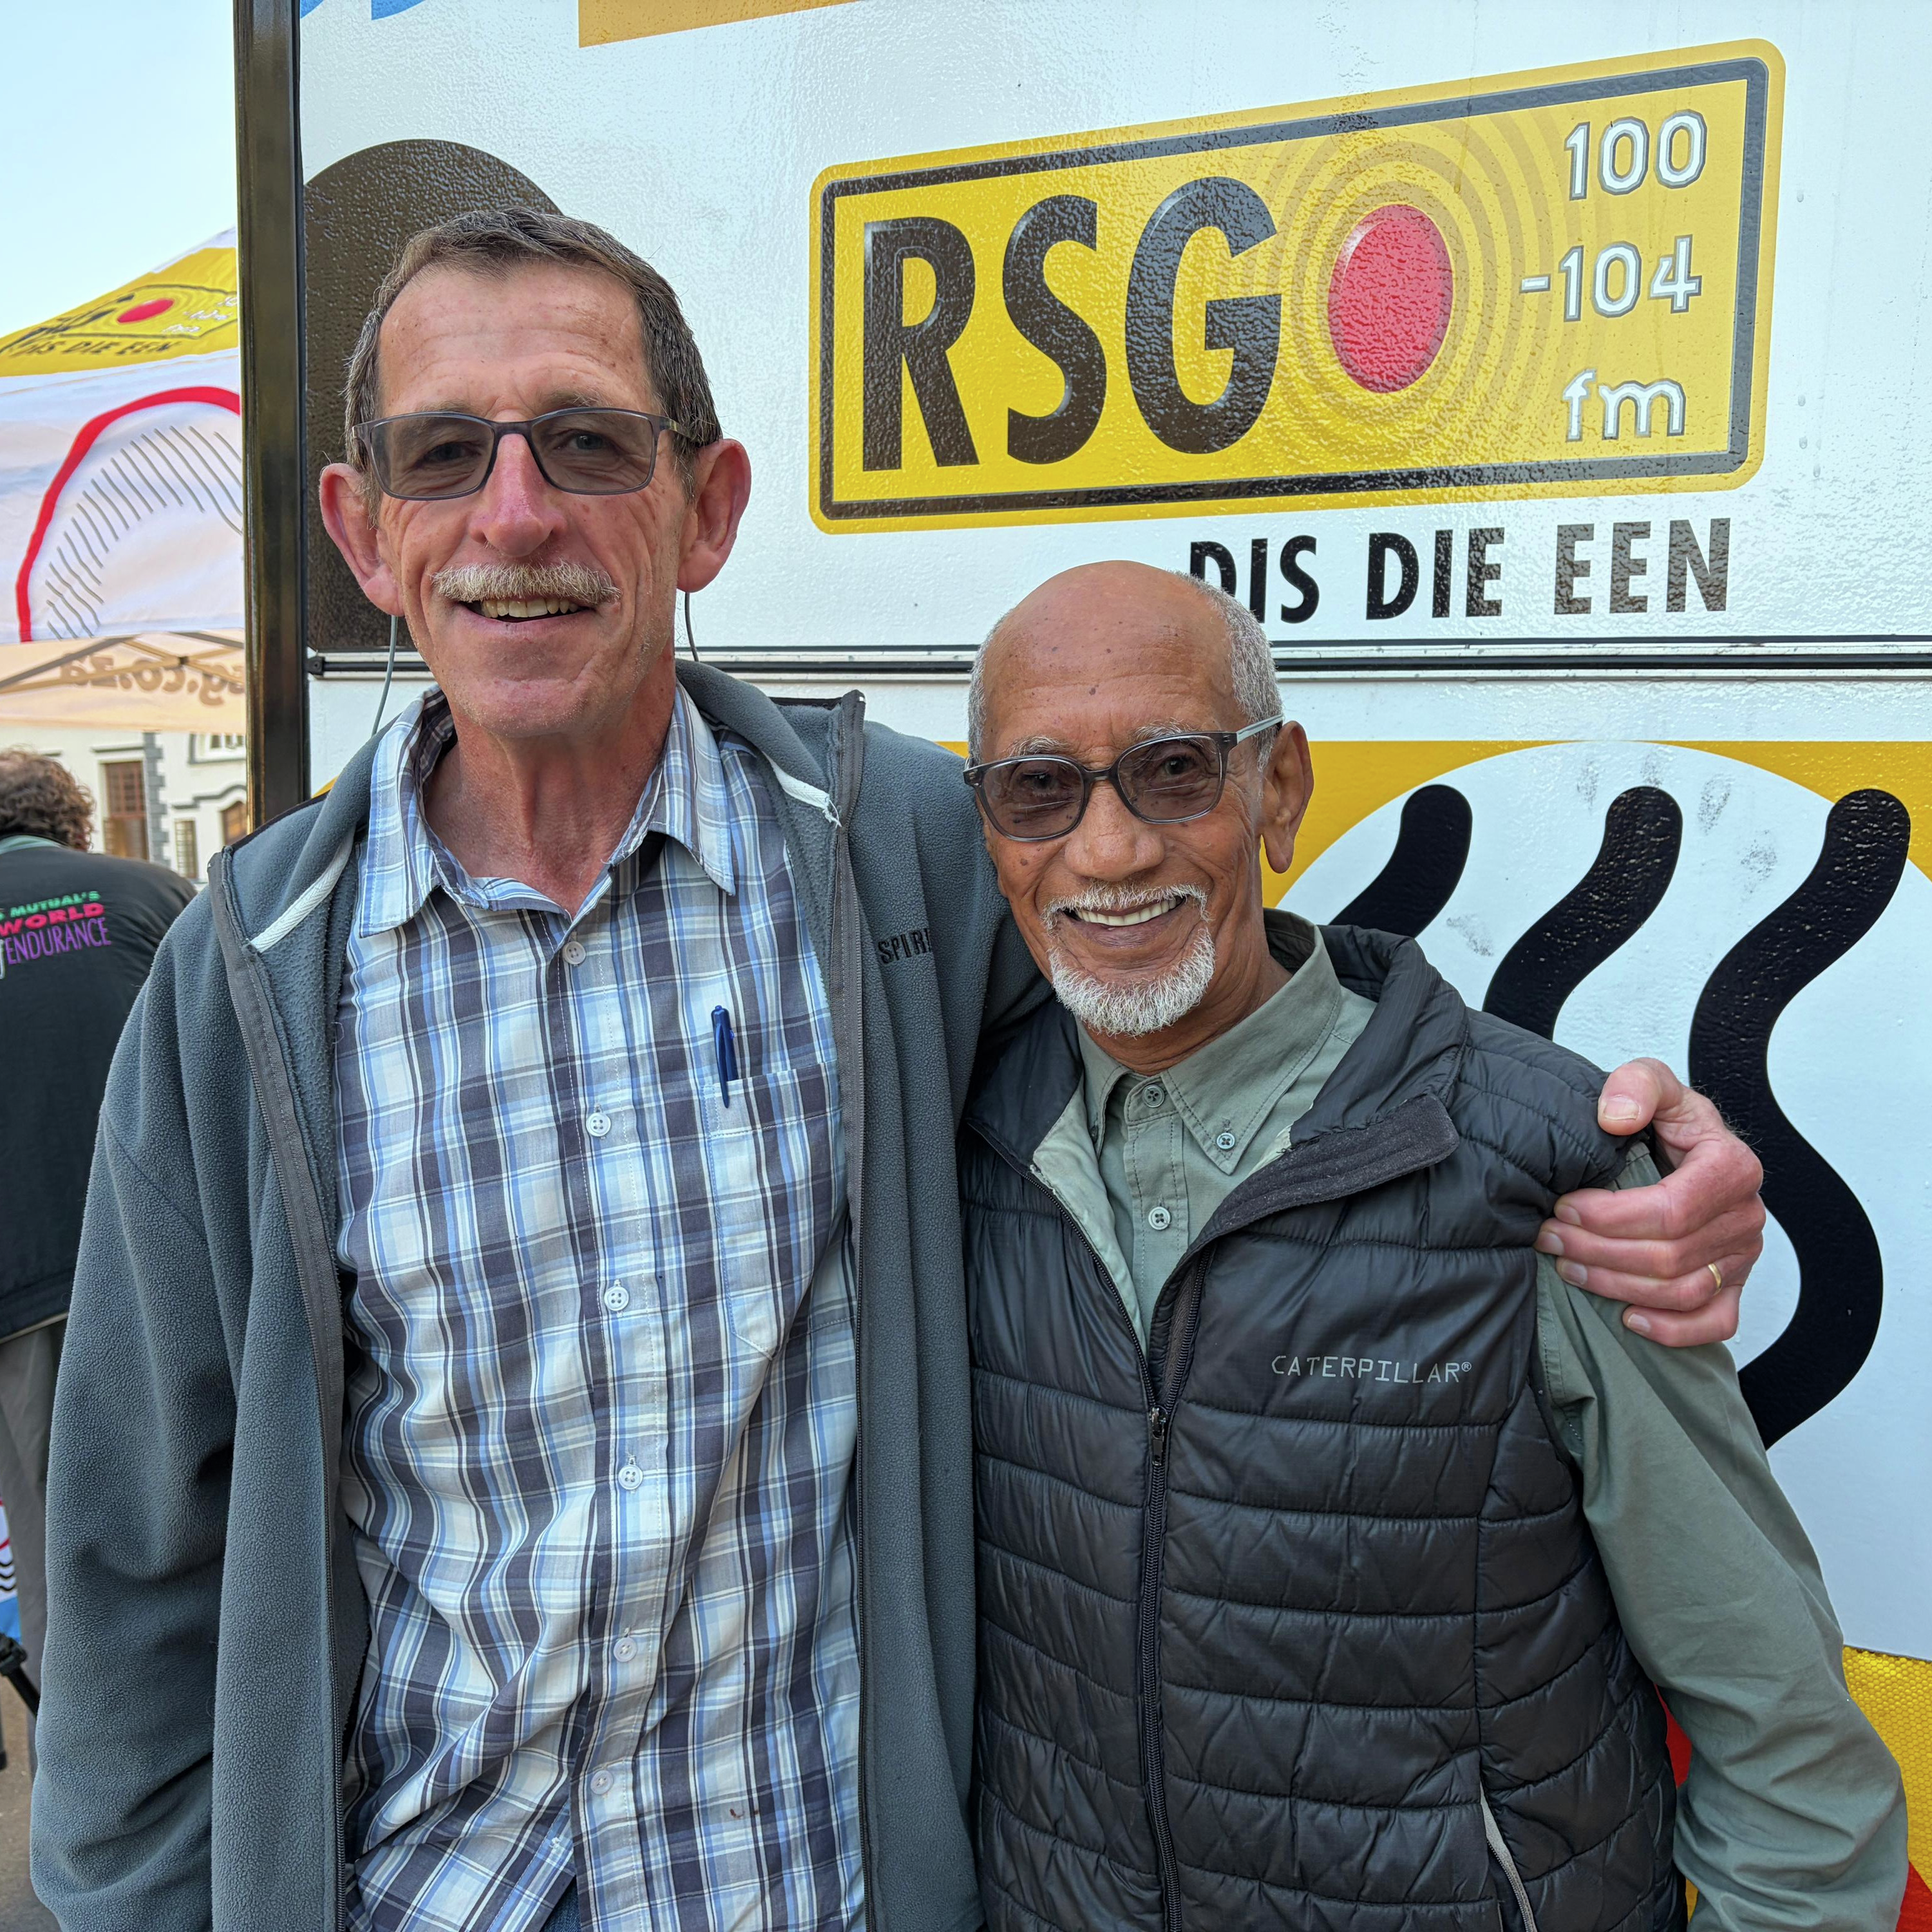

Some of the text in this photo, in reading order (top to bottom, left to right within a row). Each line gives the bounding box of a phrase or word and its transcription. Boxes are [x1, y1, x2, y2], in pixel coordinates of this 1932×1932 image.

[1564, 109, 1707, 201] 100
[1519, 234, 1702, 322] -104
[863, 176, 1282, 471] RSG
[1562, 368, 1686, 442] fm
[1190, 518, 1730, 623] DIS DIE EEN
[0, 902, 105, 936] WORLD
[5, 917, 111, 965] ENDURANCE
[10, 891, 100, 918] MUTUAL'S
